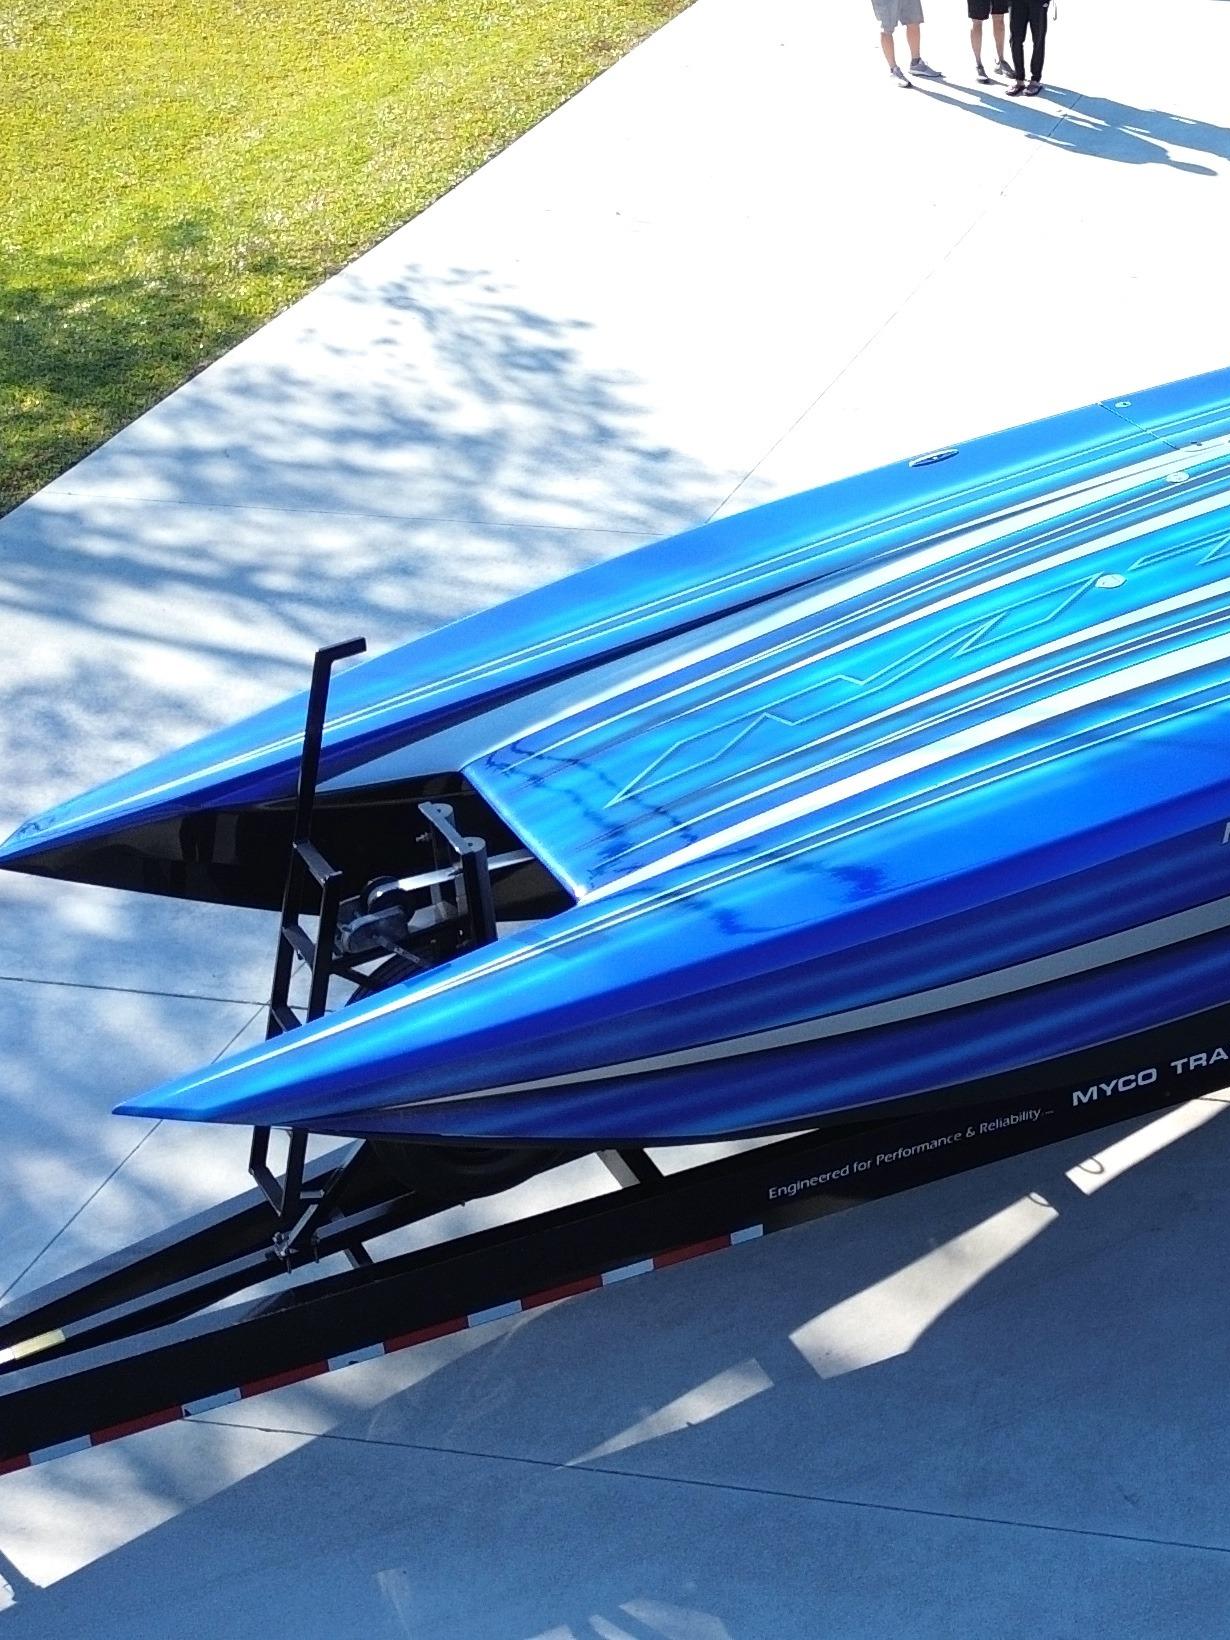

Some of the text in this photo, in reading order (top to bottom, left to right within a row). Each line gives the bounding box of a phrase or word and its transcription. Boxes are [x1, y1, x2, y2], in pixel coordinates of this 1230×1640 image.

[1073, 1067, 1157, 1106] MYCO
[768, 1108, 1041, 1200] Engineered for Performance & Reliability
